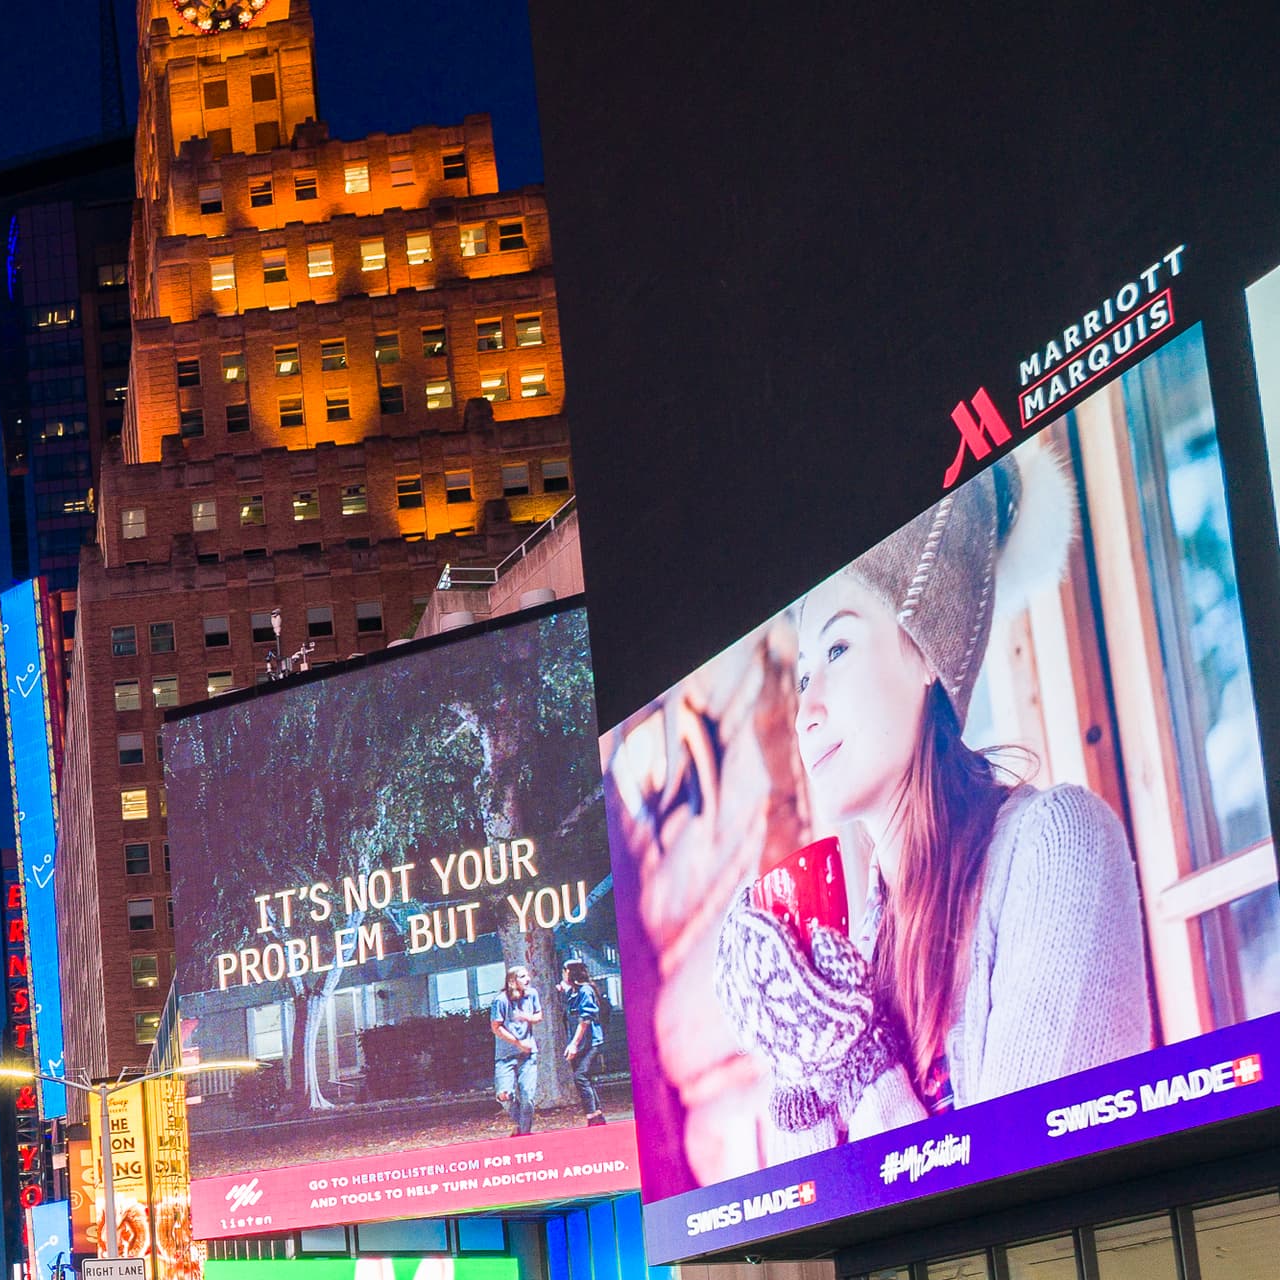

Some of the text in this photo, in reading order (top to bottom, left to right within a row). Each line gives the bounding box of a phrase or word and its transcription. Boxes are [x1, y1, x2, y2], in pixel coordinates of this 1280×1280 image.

[1019, 243, 1186, 386] MARRIOTT
[1023, 299, 1169, 421] MARQUIS
[254, 836, 539, 935] IT'S NOT YOUR
[216, 880, 589, 991] PROBLEM BUT YOU
[1045, 1061, 1238, 1138] SWISS MADE
[308, 1150, 544, 1192] GO TO HERETOLISTEN.COM FOR TIPS
[309, 1159, 631, 1209] AND TOOLS TO HELP TURN ADDICTION AROUND.
[686, 1188, 800, 1236] SWISS MADE
[86, 1265, 143, 1277] RIGHT LANE
